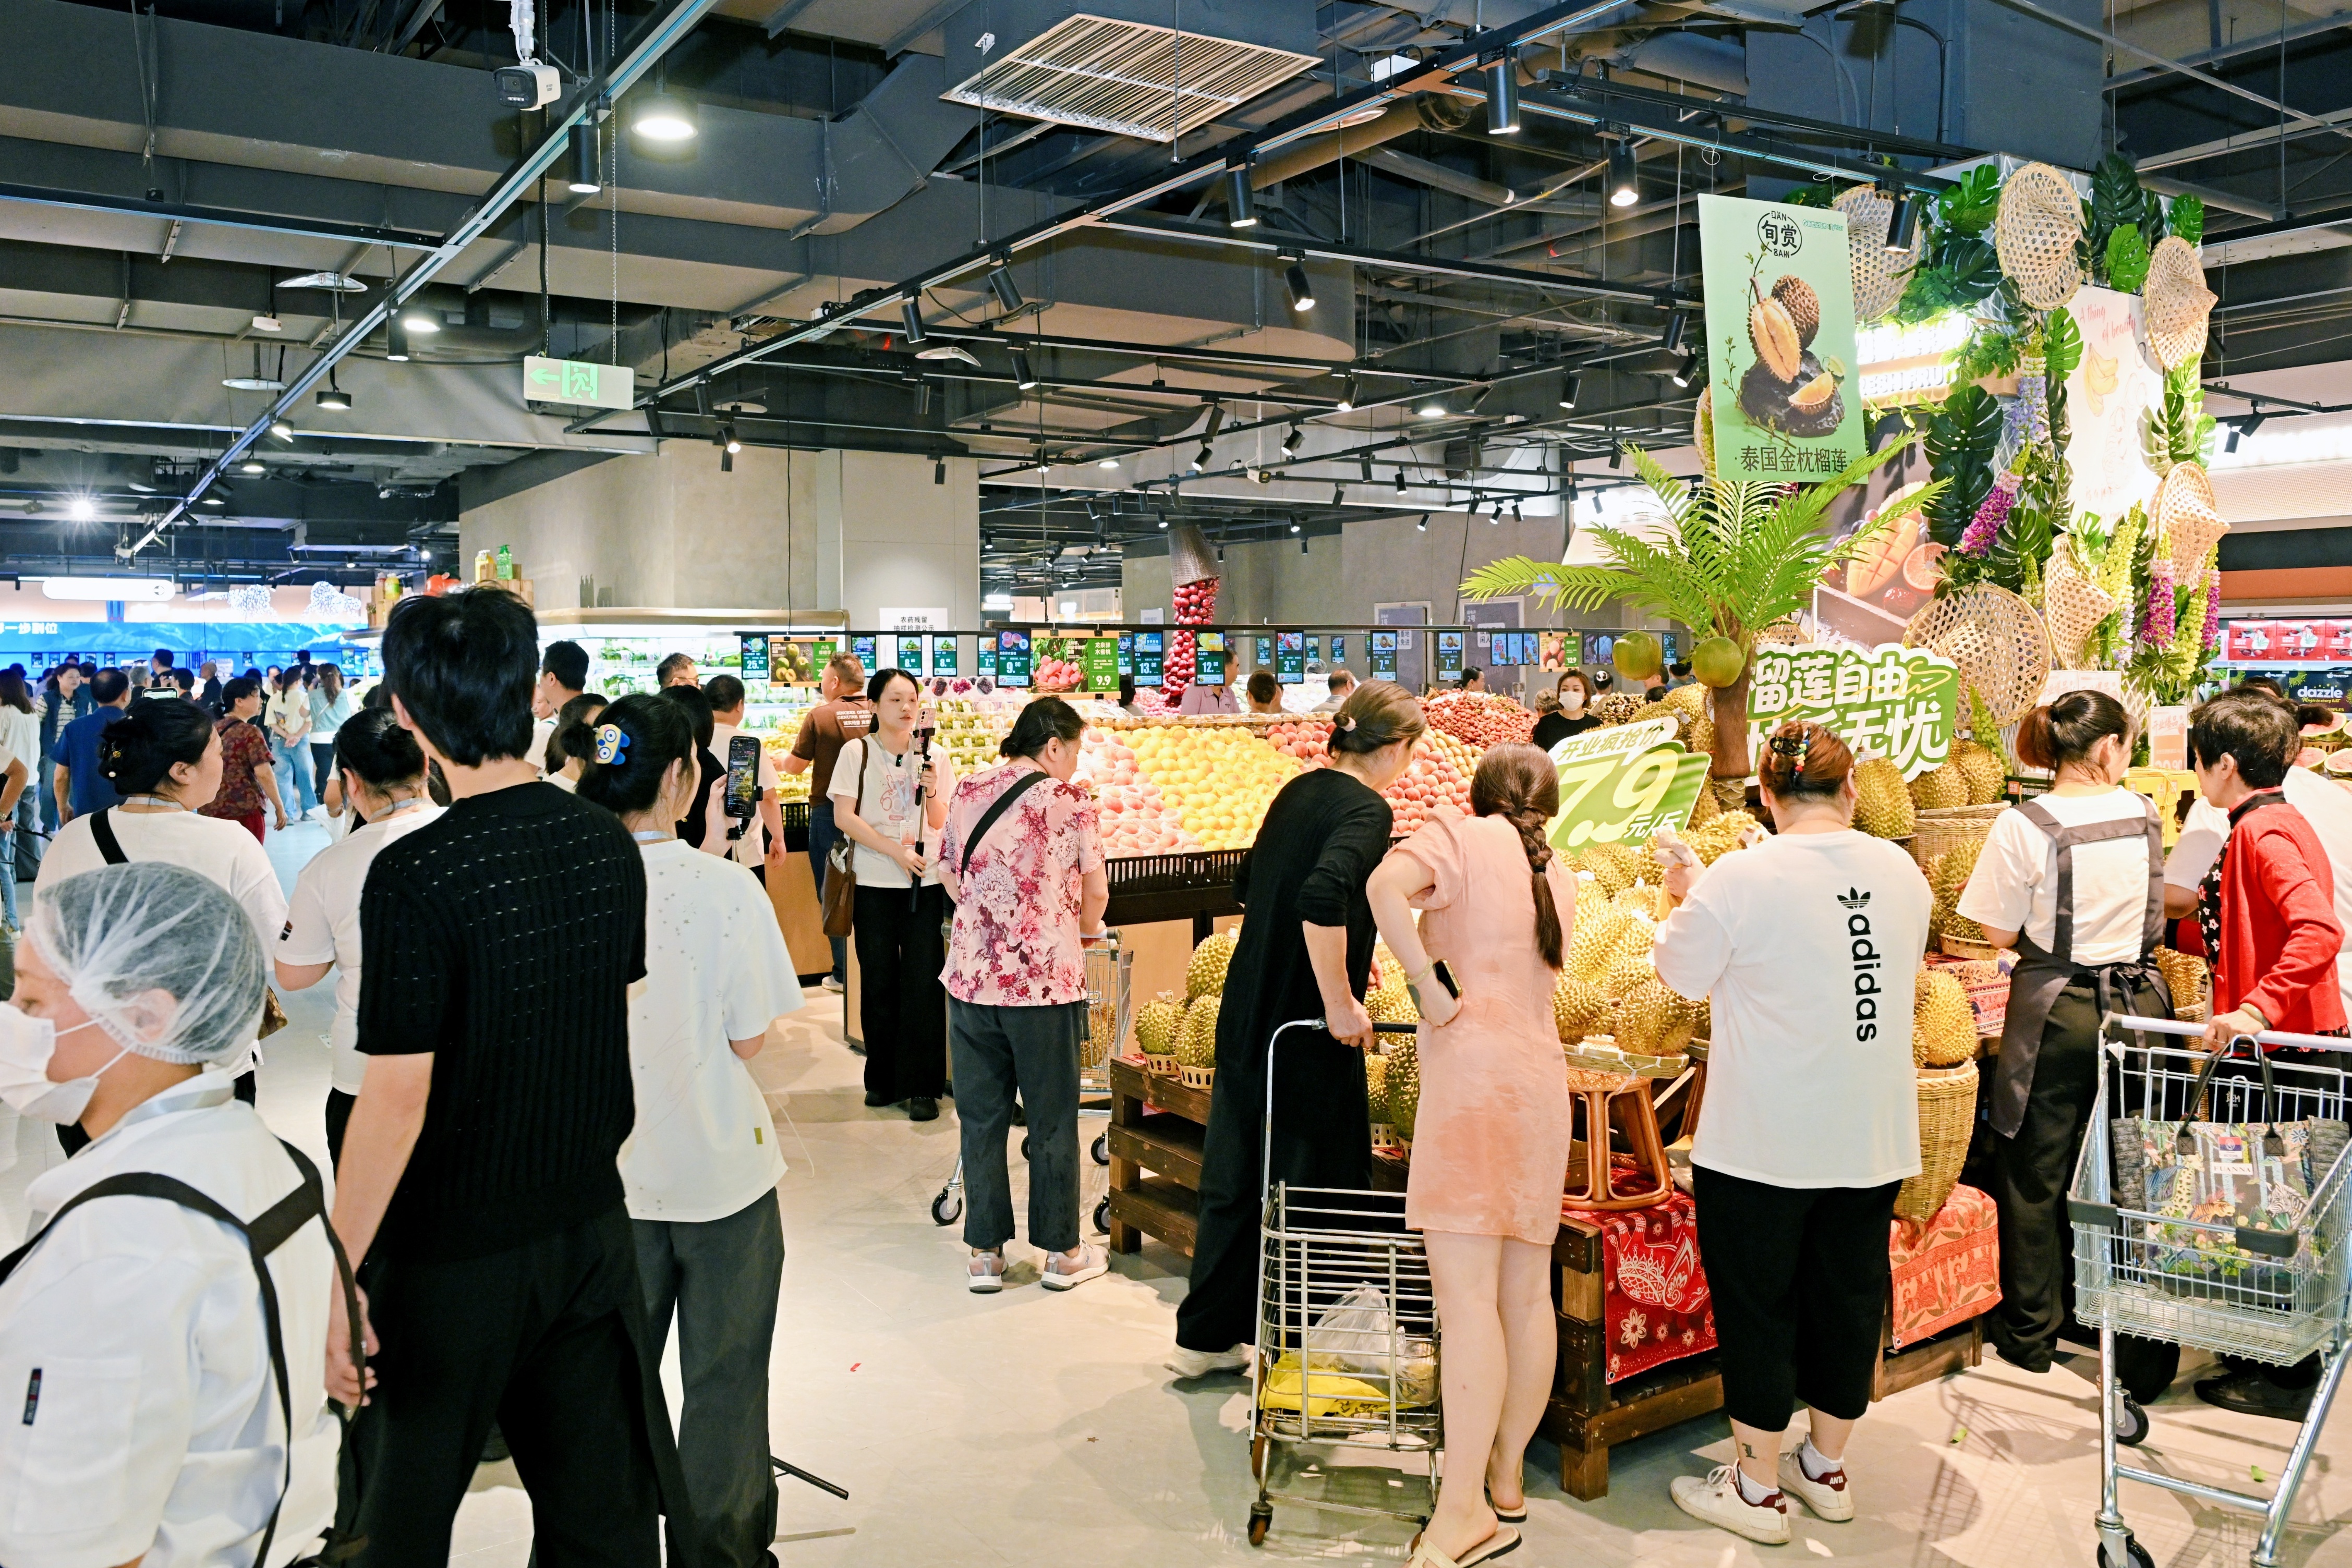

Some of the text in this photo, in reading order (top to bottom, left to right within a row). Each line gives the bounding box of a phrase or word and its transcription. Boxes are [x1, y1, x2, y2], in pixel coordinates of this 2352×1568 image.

[1761, 220, 1797, 249] 旬赏
[2088, 303, 2105, 324] thing
[2111, 313, 2136, 337] beauty
[1859, 372, 1904, 396] RESH
[1740, 445, 1848, 473] 泰国金枕榴莲
[0, 622, 58, 635] 一步到位
[1096, 675, 1111, 686] 9.9
[2297, 686, 2343, 698] dazzle
[1557, 722, 1665, 762] 开业疯抢价
[1546, 749, 1679, 847] 7.9
[2021, 787, 2052, 796] 泰国精品
[1848, 914, 1882, 1042] adidas
[2214, 1164, 2251, 1173] FUANNA
[1829, 1475, 1844, 1485] ANTA
